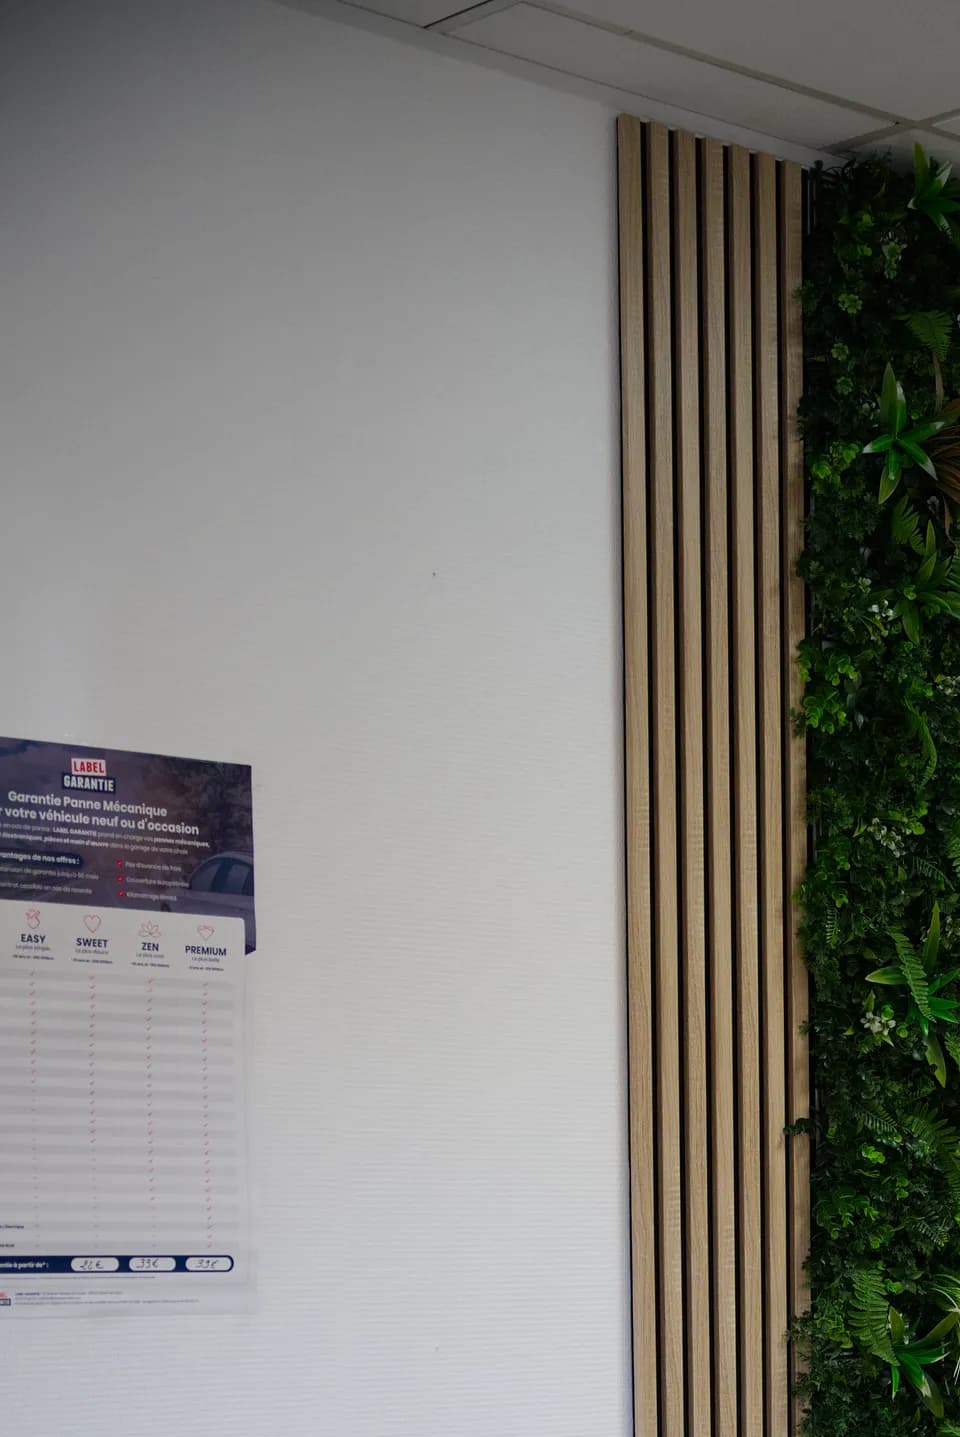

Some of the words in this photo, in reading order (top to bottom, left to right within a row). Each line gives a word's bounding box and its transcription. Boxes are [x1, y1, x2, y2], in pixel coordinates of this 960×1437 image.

[73, 760, 105, 773] LABEL
[63, 775, 114, 792] GARANTIE
[8, 790, 61, 806] Garantie
[63, 796, 102, 811] Panne
[103, 800, 167, 818] Mécanique
[5, 807, 37, 819] votre
[39, 809, 90, 823] véhicule
[92, 815, 119, 827] neuf
[120, 819, 135, 829] ou
[137, 818, 199, 835] d'occasion
[20, 933, 46, 944] EASY
[75, 937, 108, 948] SWEET
[141, 942, 159, 951] ZEN
[185, 945, 227, 956] PREMIUM
